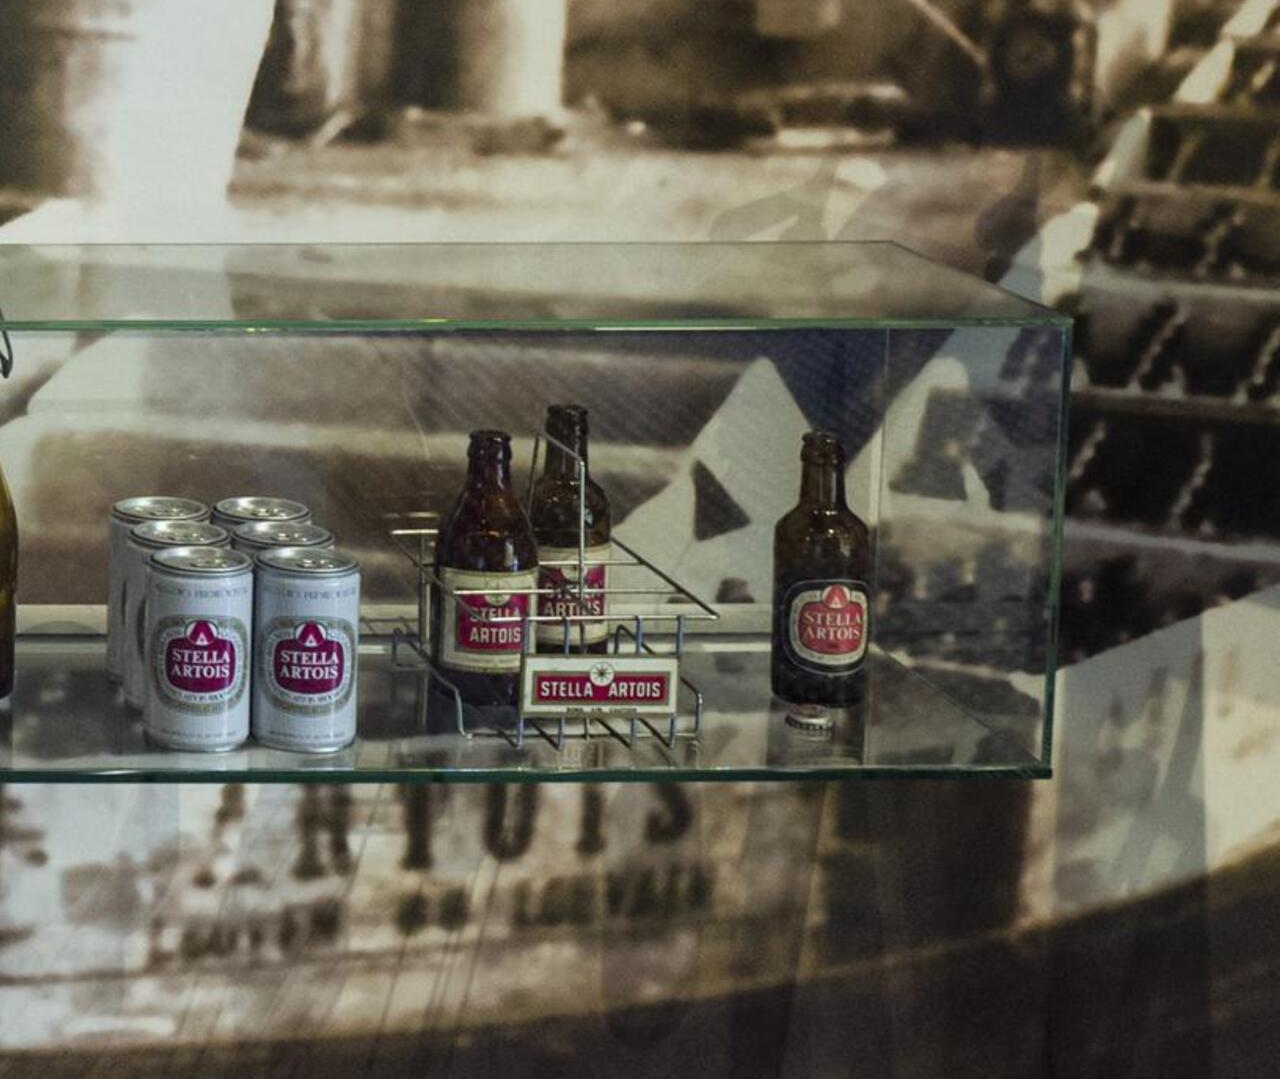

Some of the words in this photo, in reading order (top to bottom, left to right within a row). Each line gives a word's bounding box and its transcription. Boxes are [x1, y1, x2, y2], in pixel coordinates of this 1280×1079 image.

[803, 611, 864, 626] STELLA
[469, 627, 522, 643] ARTOIS
[803, 626, 861, 640] ARTOIS
[171, 648, 231, 664] STELLA
[280, 649, 340, 666] STELLA
[171, 663, 231, 679] ARTOIS
[280, 665, 339, 680] ARTOIS
[541, 681, 593, 697] STELLA
[608, 682, 661, 697] ARTOIS
